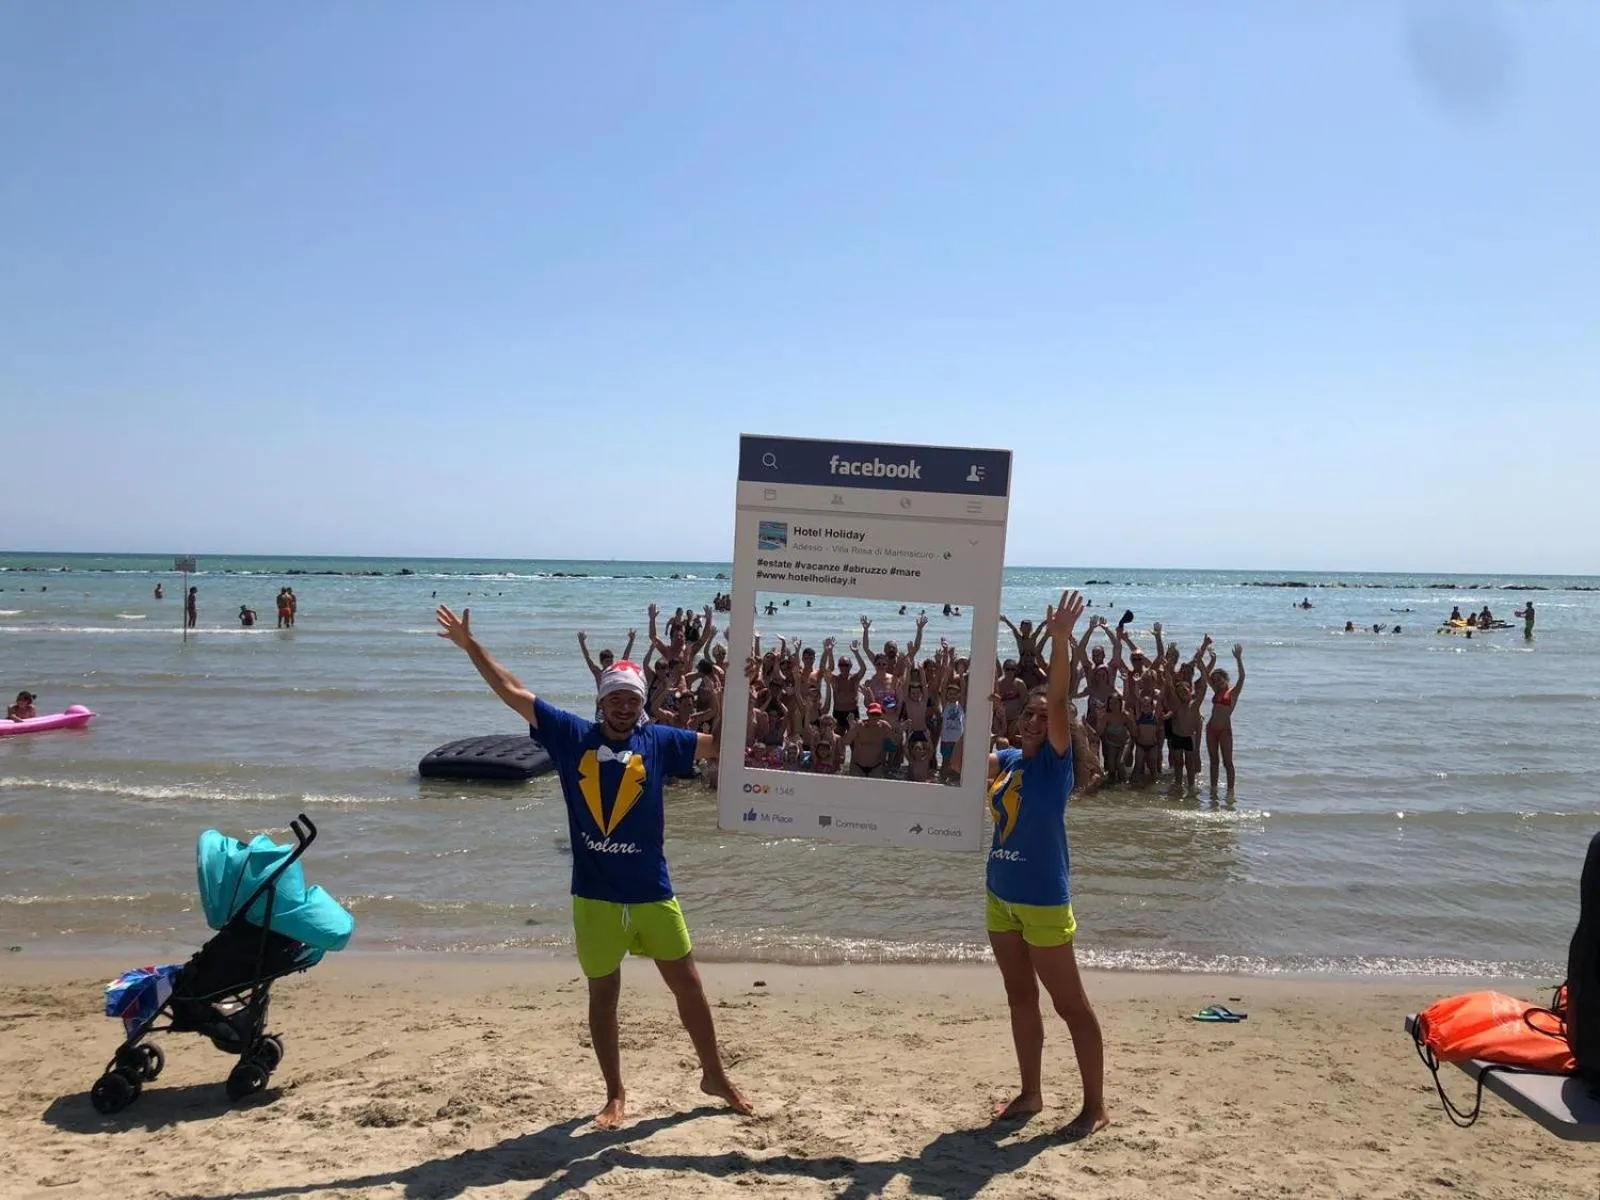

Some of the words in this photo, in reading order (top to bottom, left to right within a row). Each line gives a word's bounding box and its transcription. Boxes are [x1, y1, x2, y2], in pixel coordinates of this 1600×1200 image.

[829, 454, 922, 480] facebook
[793, 526, 822, 538] Hotel
[824, 528, 866, 542] Holiday
[792, 542, 823, 552] Adesso
[832, 544, 849, 554] Villa
[852, 546, 872, 555] Rosa
[875, 547, 882, 556] di
[757, 558, 793, 569] #estate
[794, 560, 840, 572] #vacanze
[842, 563, 888, 575] #abruzzo
[890, 566, 921, 578] #mare
[756, 570, 857, 587] #www.hotelholiday.it
